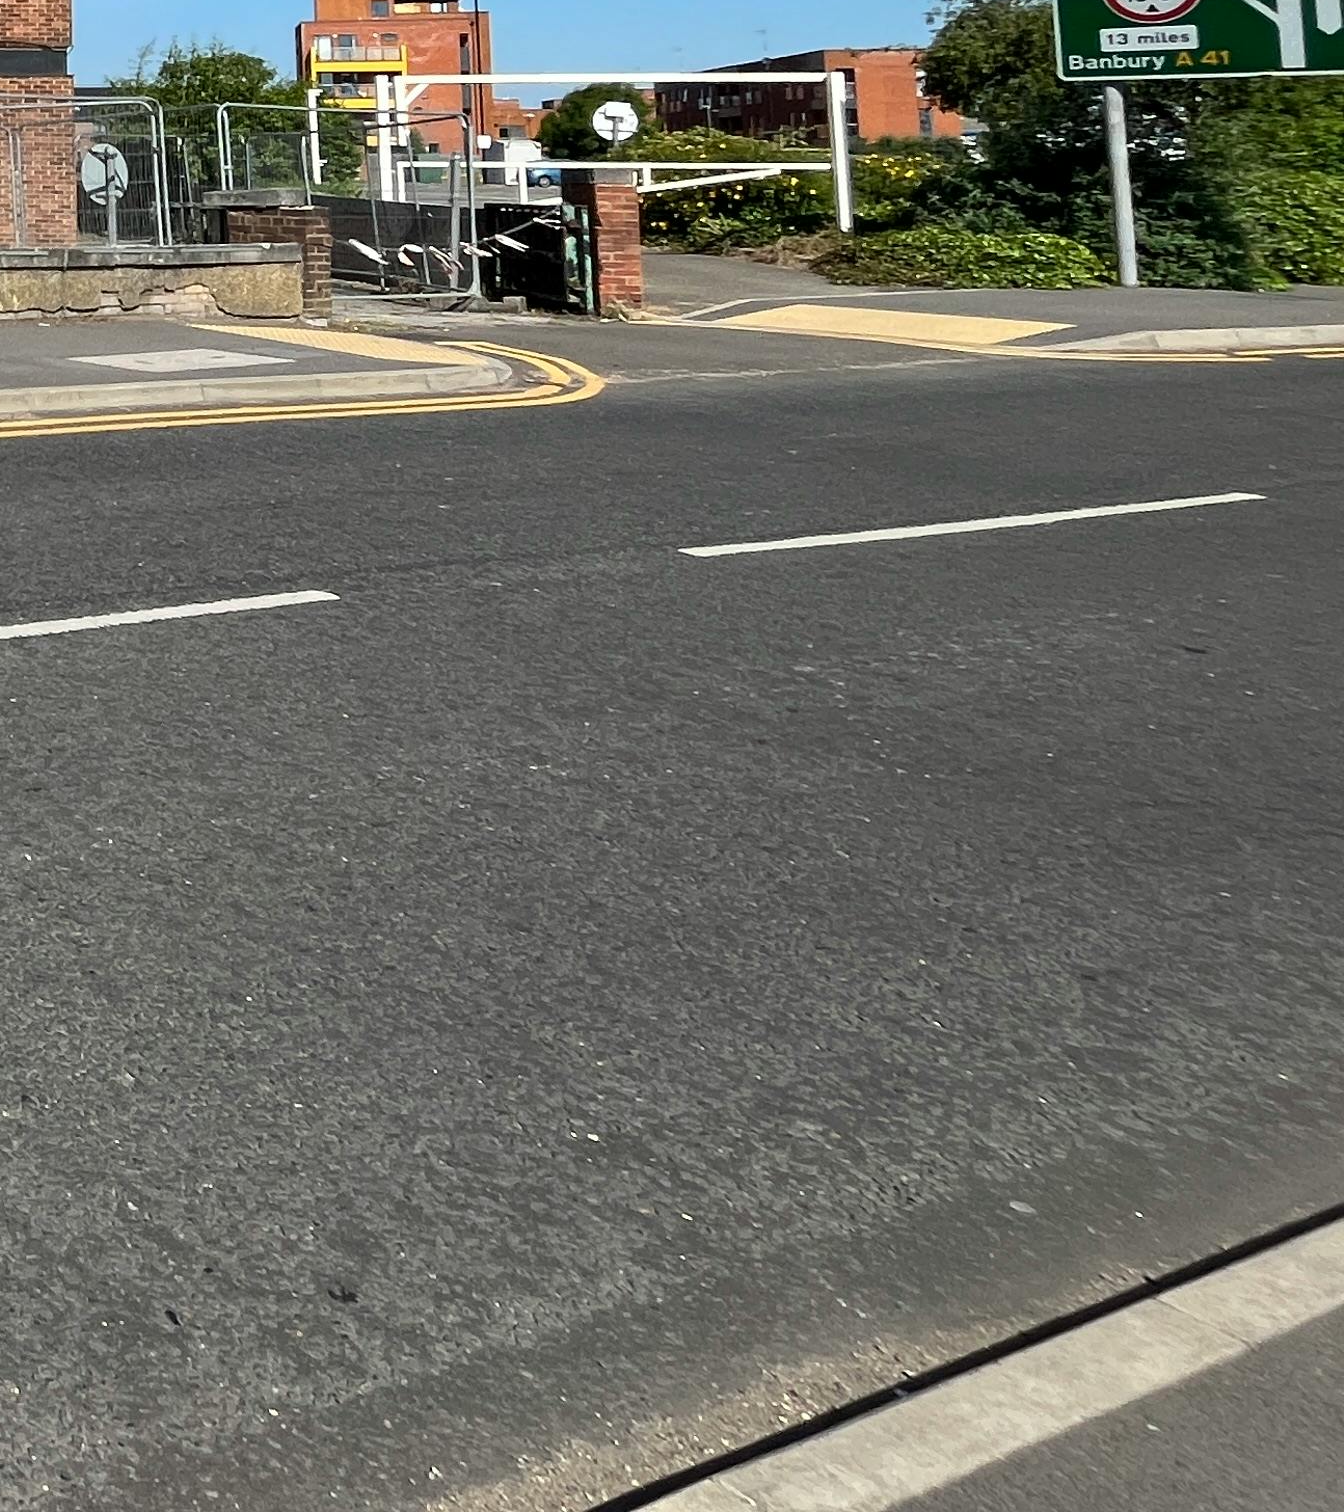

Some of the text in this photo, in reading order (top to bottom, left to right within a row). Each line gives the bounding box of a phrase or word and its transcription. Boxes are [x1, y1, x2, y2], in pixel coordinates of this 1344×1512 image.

[1107, 31, 1190, 45] 13 miles
[1068, 50, 1230, 70] Banbury A 41
